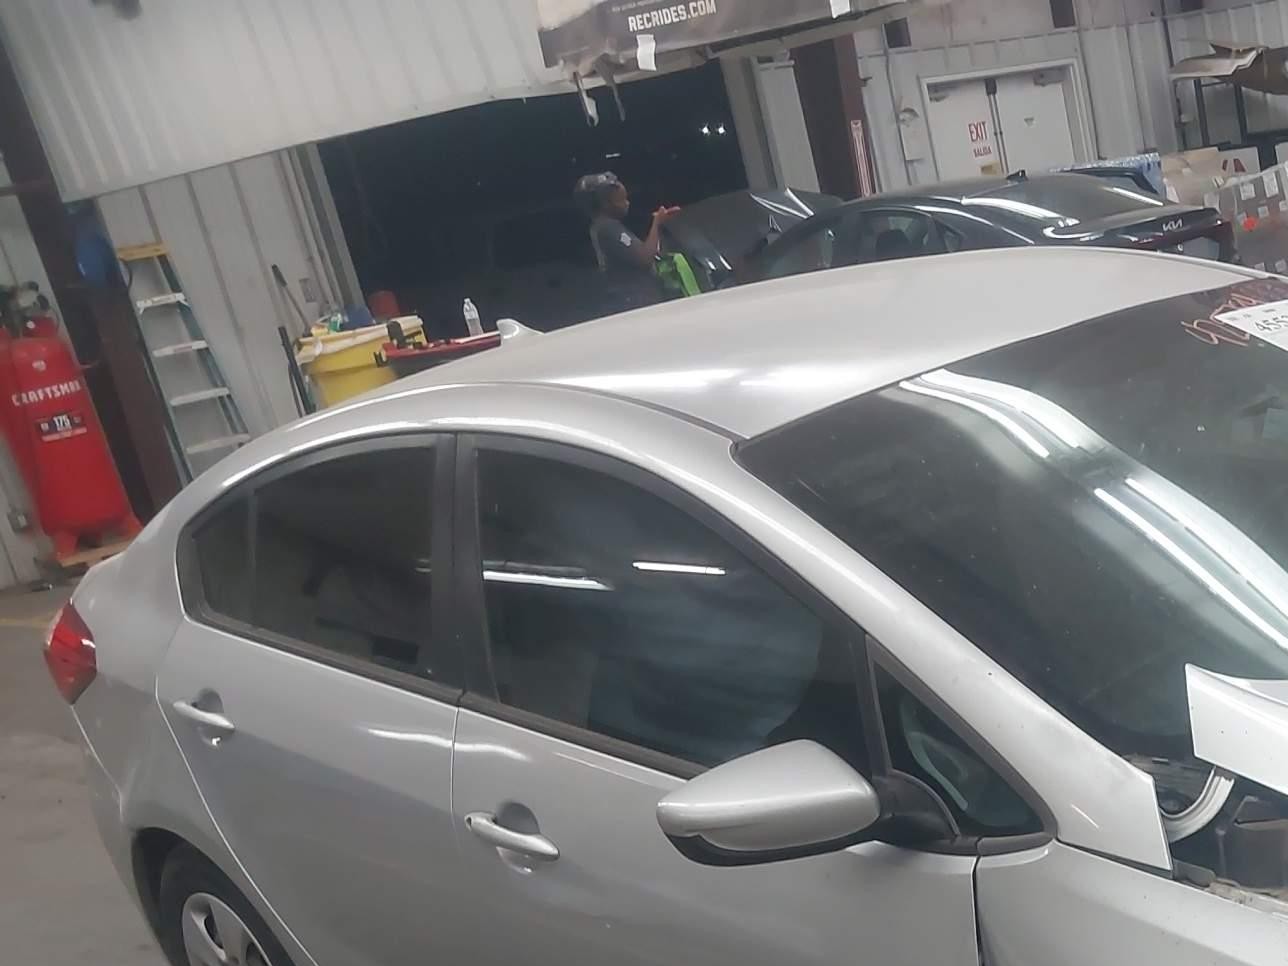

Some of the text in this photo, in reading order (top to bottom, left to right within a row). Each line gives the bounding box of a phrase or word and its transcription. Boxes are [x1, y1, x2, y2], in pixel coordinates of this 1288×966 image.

[628, 0, 717, 32] RECRIDES.COM
[968, 121, 987, 142] EXIT
[53, 415, 71, 429] 175
